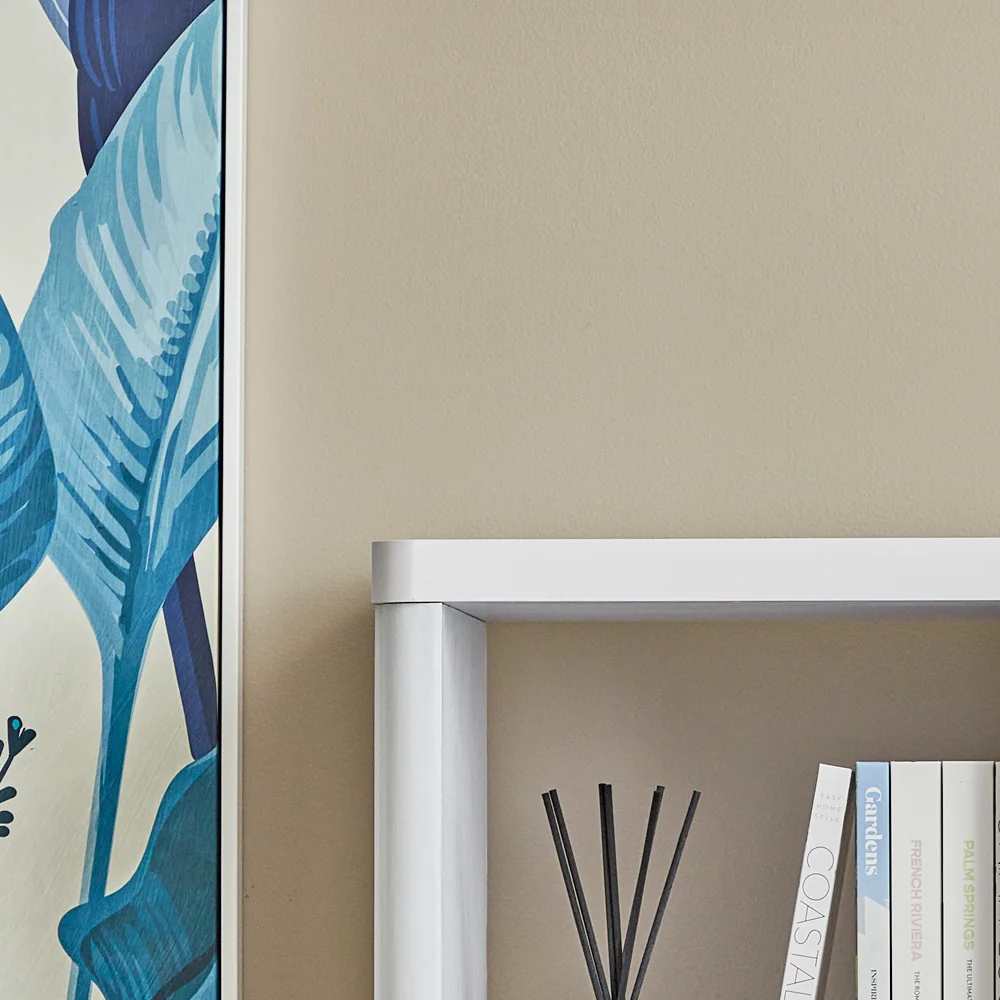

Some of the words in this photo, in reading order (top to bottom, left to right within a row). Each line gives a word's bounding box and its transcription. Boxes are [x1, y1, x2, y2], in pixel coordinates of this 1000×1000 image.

[814, 813, 840, 823] STYLE
[816, 803, 842, 813] HOME
[820, 793, 842, 801] EASY
[865, 786, 883, 876] Gardens
[910, 840, 923, 900] FRENCH
[963, 840, 975, 882] PALM
[910, 903, 923, 962] RIVIERA
[963, 884, 975, 951] SPRINGS
